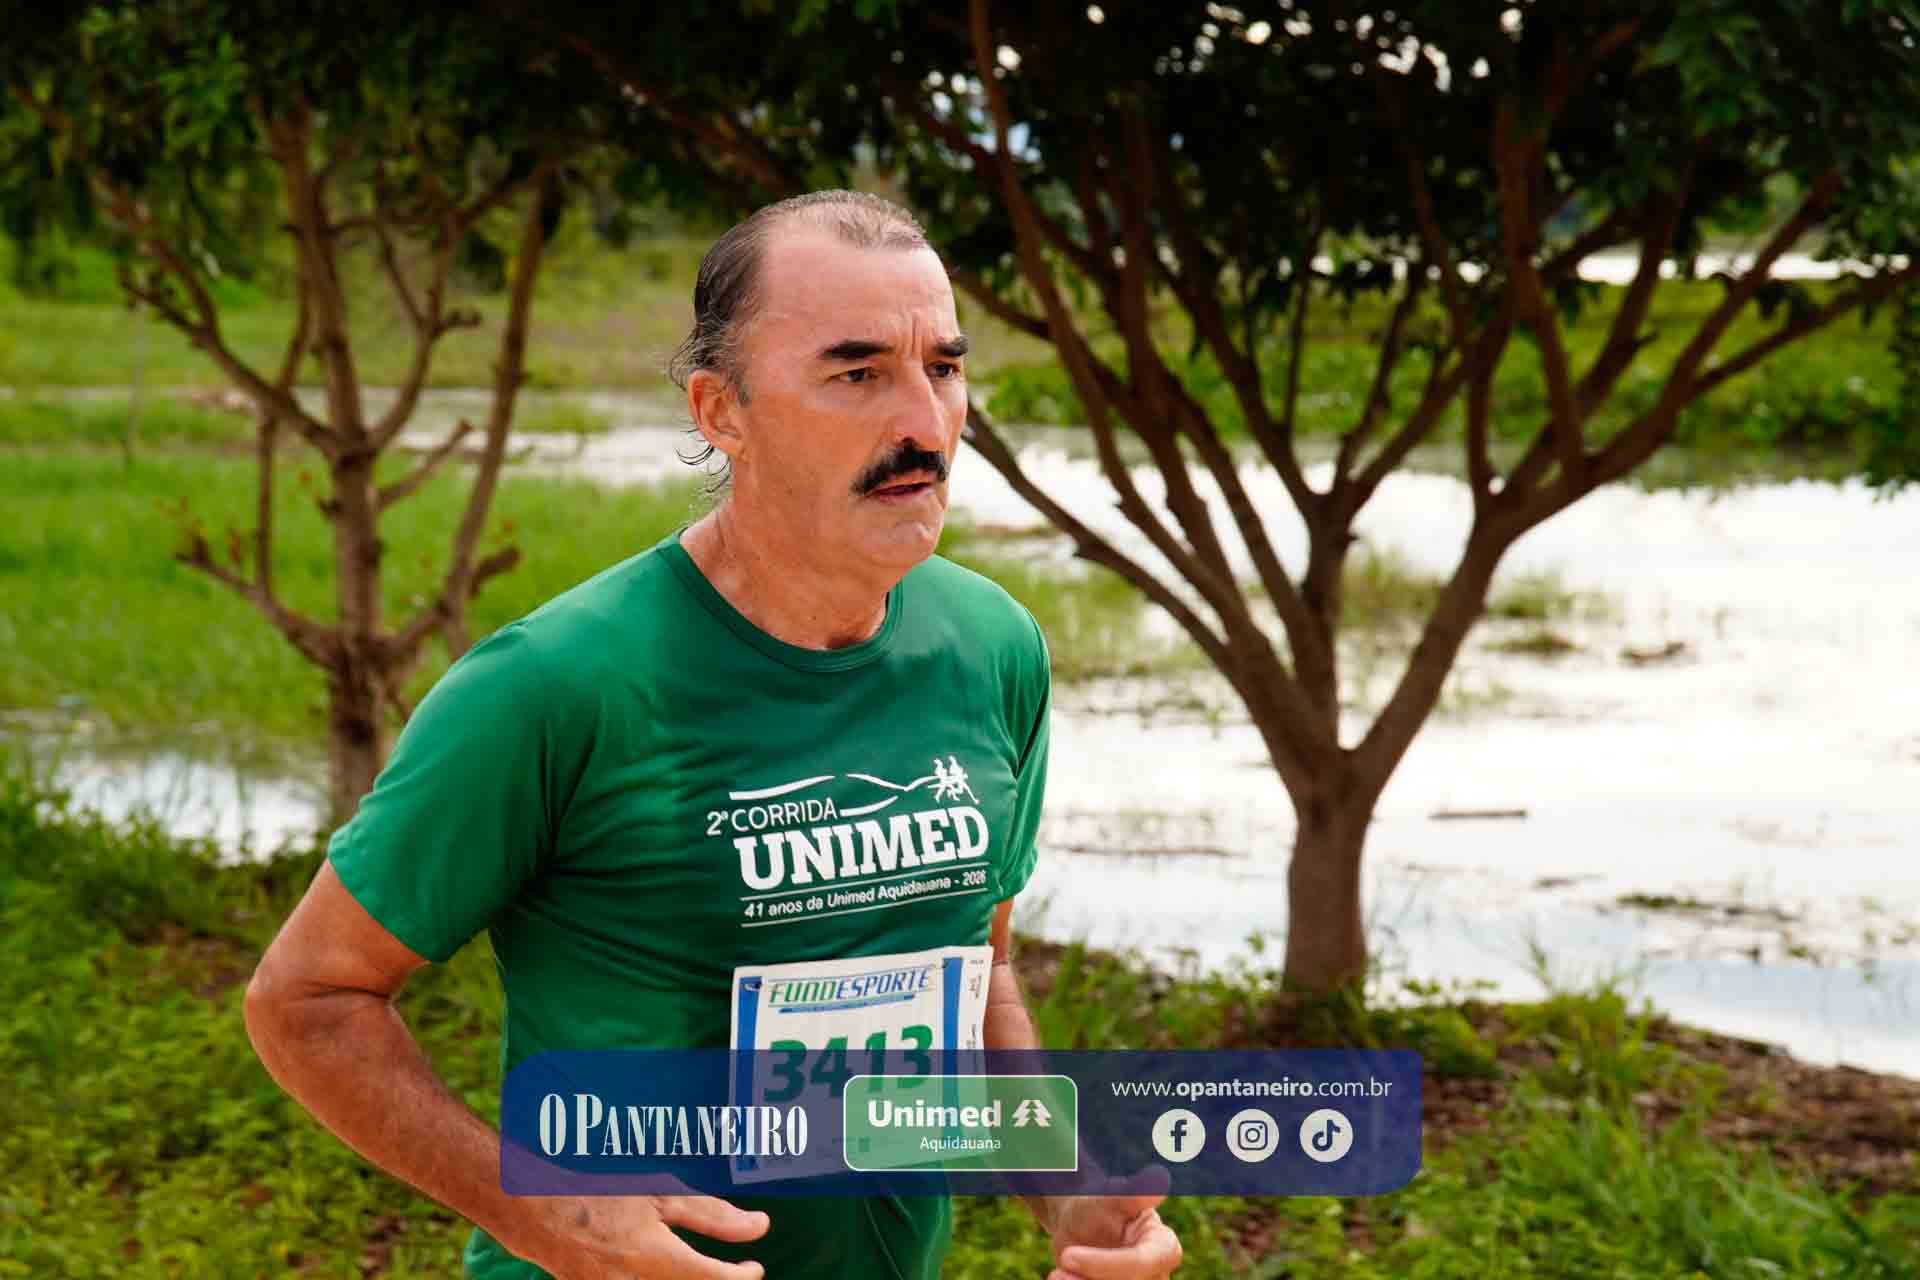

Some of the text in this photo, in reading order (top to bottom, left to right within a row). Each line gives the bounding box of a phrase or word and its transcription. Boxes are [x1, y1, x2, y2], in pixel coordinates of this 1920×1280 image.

[731, 798, 838, 832] CORRIDA
[733, 806, 989, 890] UNIMED
[744, 903, 764, 918] 41
[768, 901, 803, 916] anos
[806, 896, 824, 911] da
[827, 888, 876, 908] Unimed
[878, 876, 951, 900] Aquidauana
[769, 968, 930, 1003] FUNDESPORTE
[763, 1025, 934, 1101] 3413
